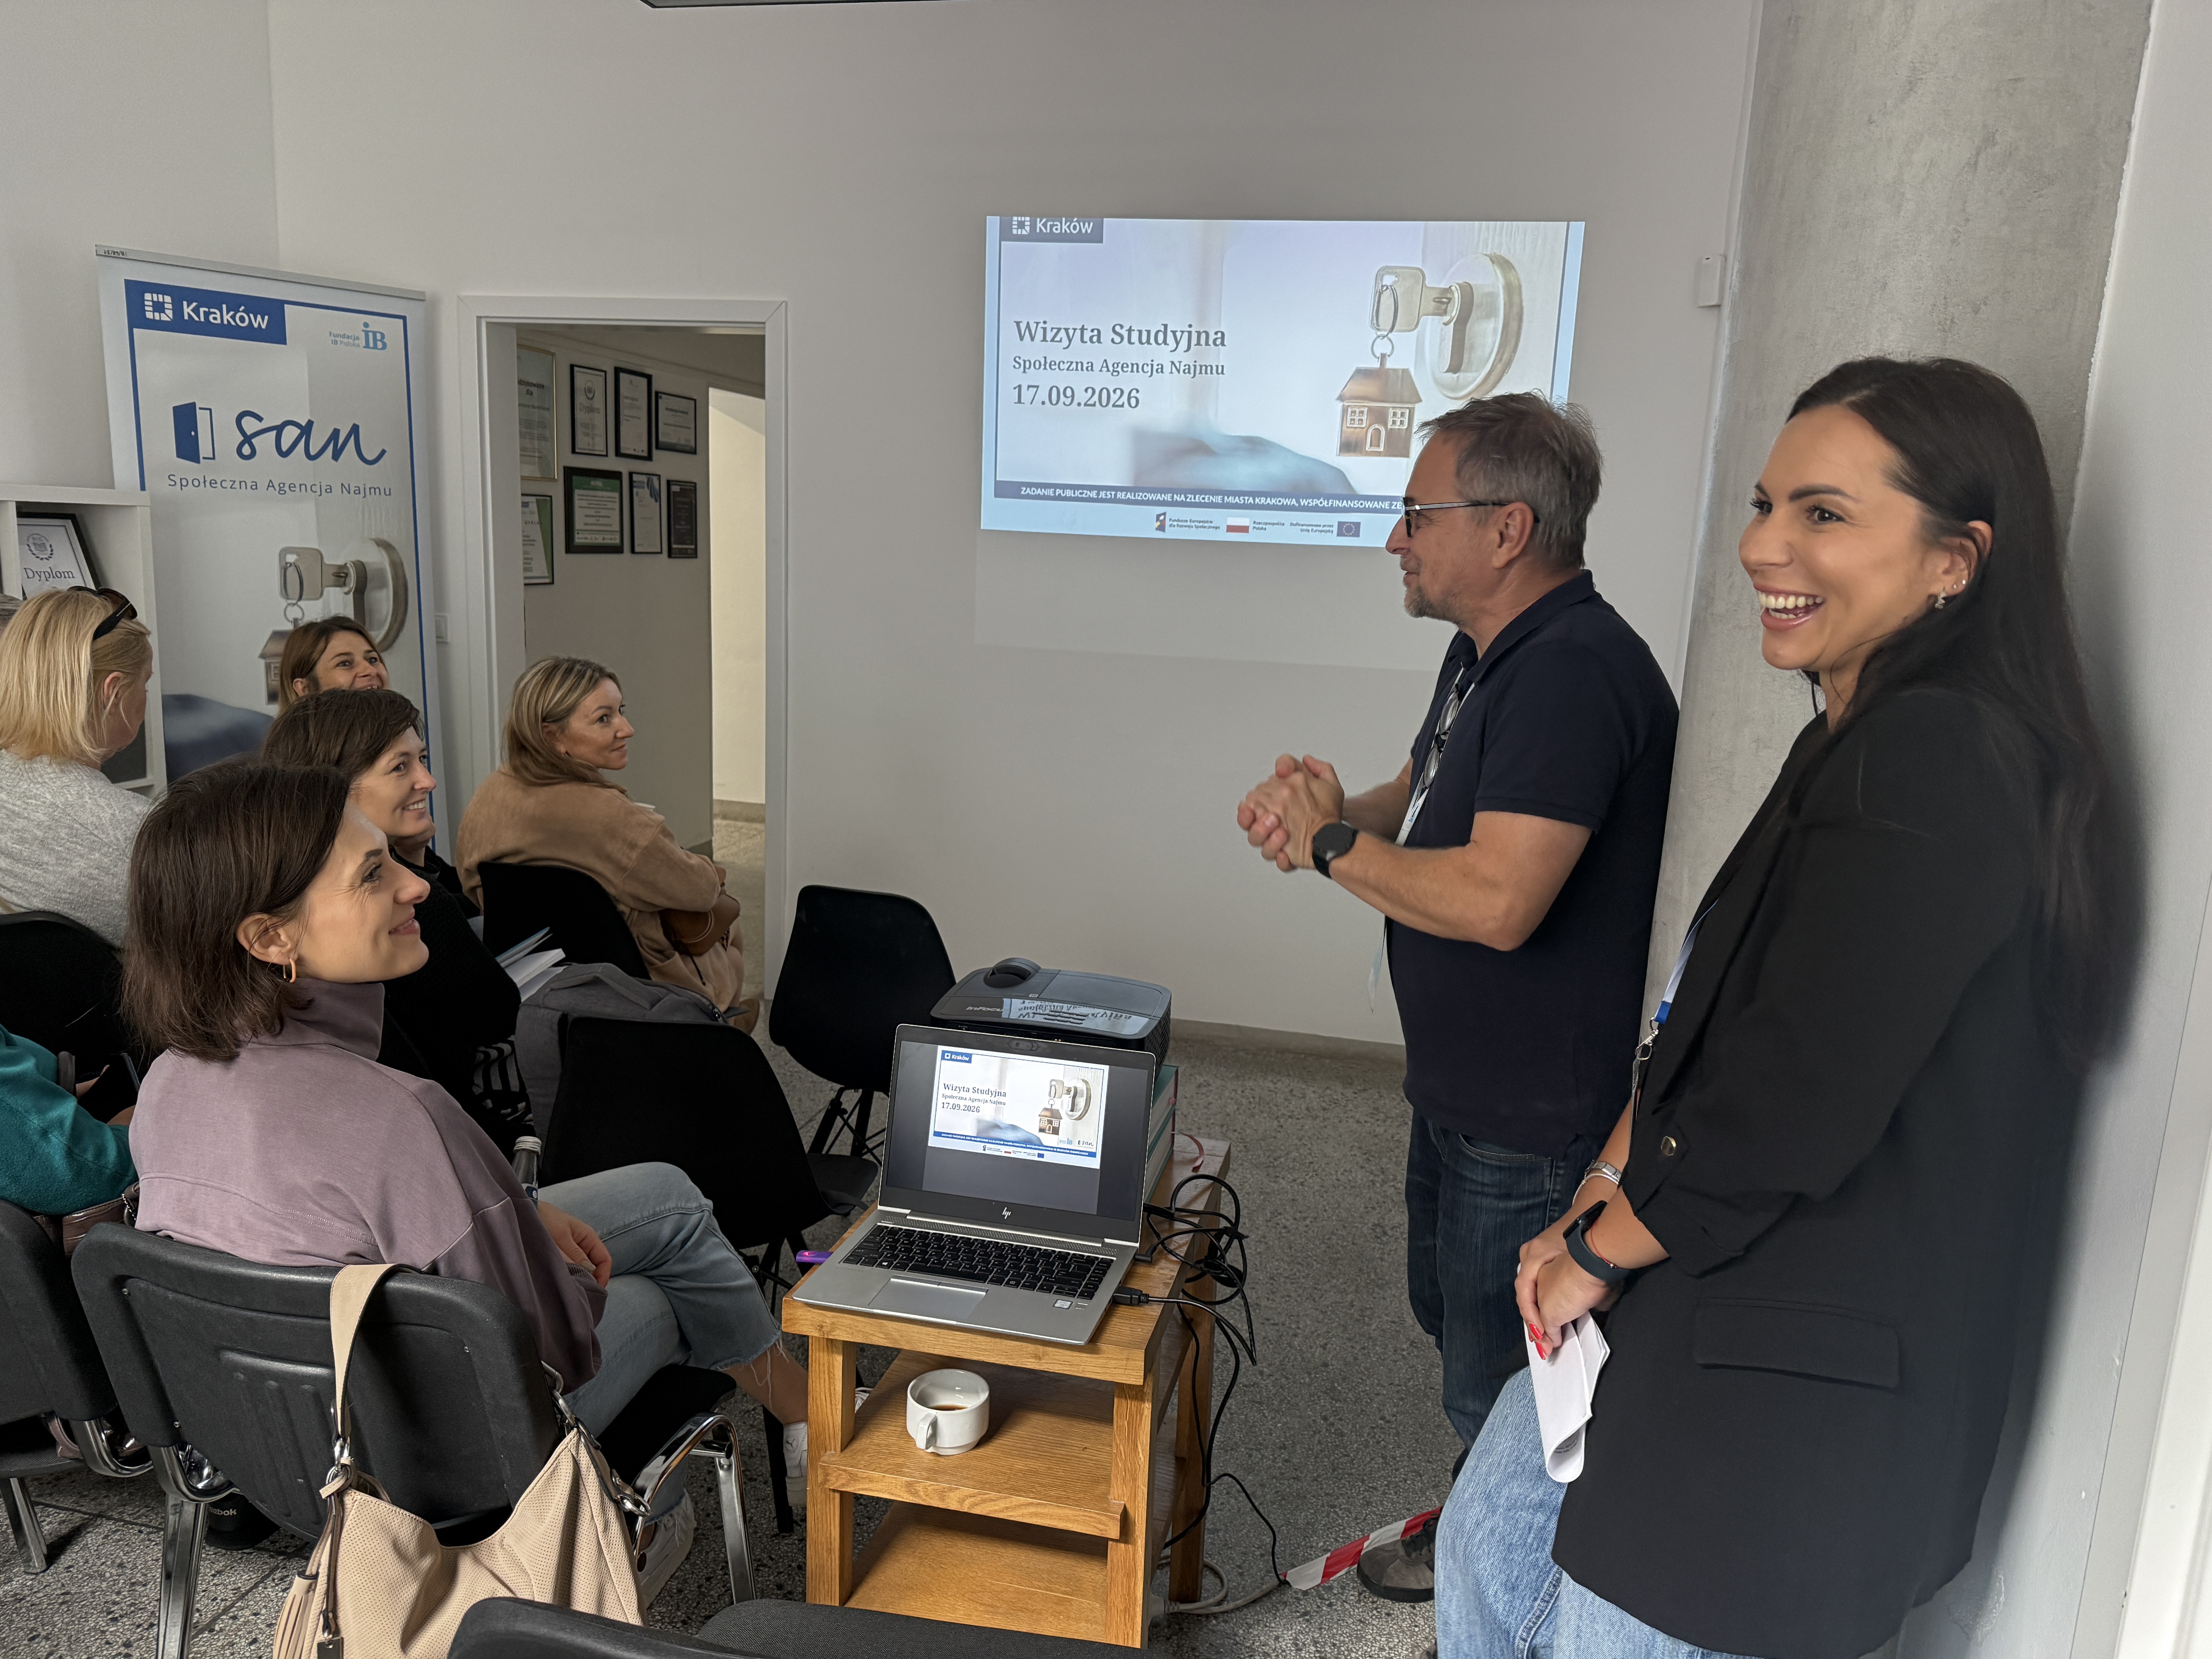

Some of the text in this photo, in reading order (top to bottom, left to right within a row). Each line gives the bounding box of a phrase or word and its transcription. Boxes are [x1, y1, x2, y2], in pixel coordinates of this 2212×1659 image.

[1036, 218, 1093, 234] Kraków
[183, 301, 268, 329] Kraków
[329, 331, 359, 341] Fundacja
[1013, 321, 1226, 353] Wizyta Studyjna
[1013, 356, 1225, 378] Społeczna Agencja Najmu
[1013, 383, 1140, 409] 17.09.2026
[235, 410, 386, 465] san
[168, 474, 392, 498] Społeczna Agencja Najmu
[1021, 488, 1054, 496] ZADANIE
[1056, 489, 1097, 498] PUBLICZNE
[1098, 491, 1115, 499] JEST
[1117, 492, 1172, 501] REALIZOWANE
[1186, 495, 1222, 503] ZLECENIE
[1224, 496, 1254, 504] MIASTA
[1255, 497, 1298, 506] KRAKOWA,
[1300, 498, 1389, 509] WSPÓŁFINANSOWANE
[23, 567, 75, 581] Dyplom
[943, 1083, 1006, 1098] Wizyta Studyjna
[941, 1102, 980, 1113] 17.09.2026
